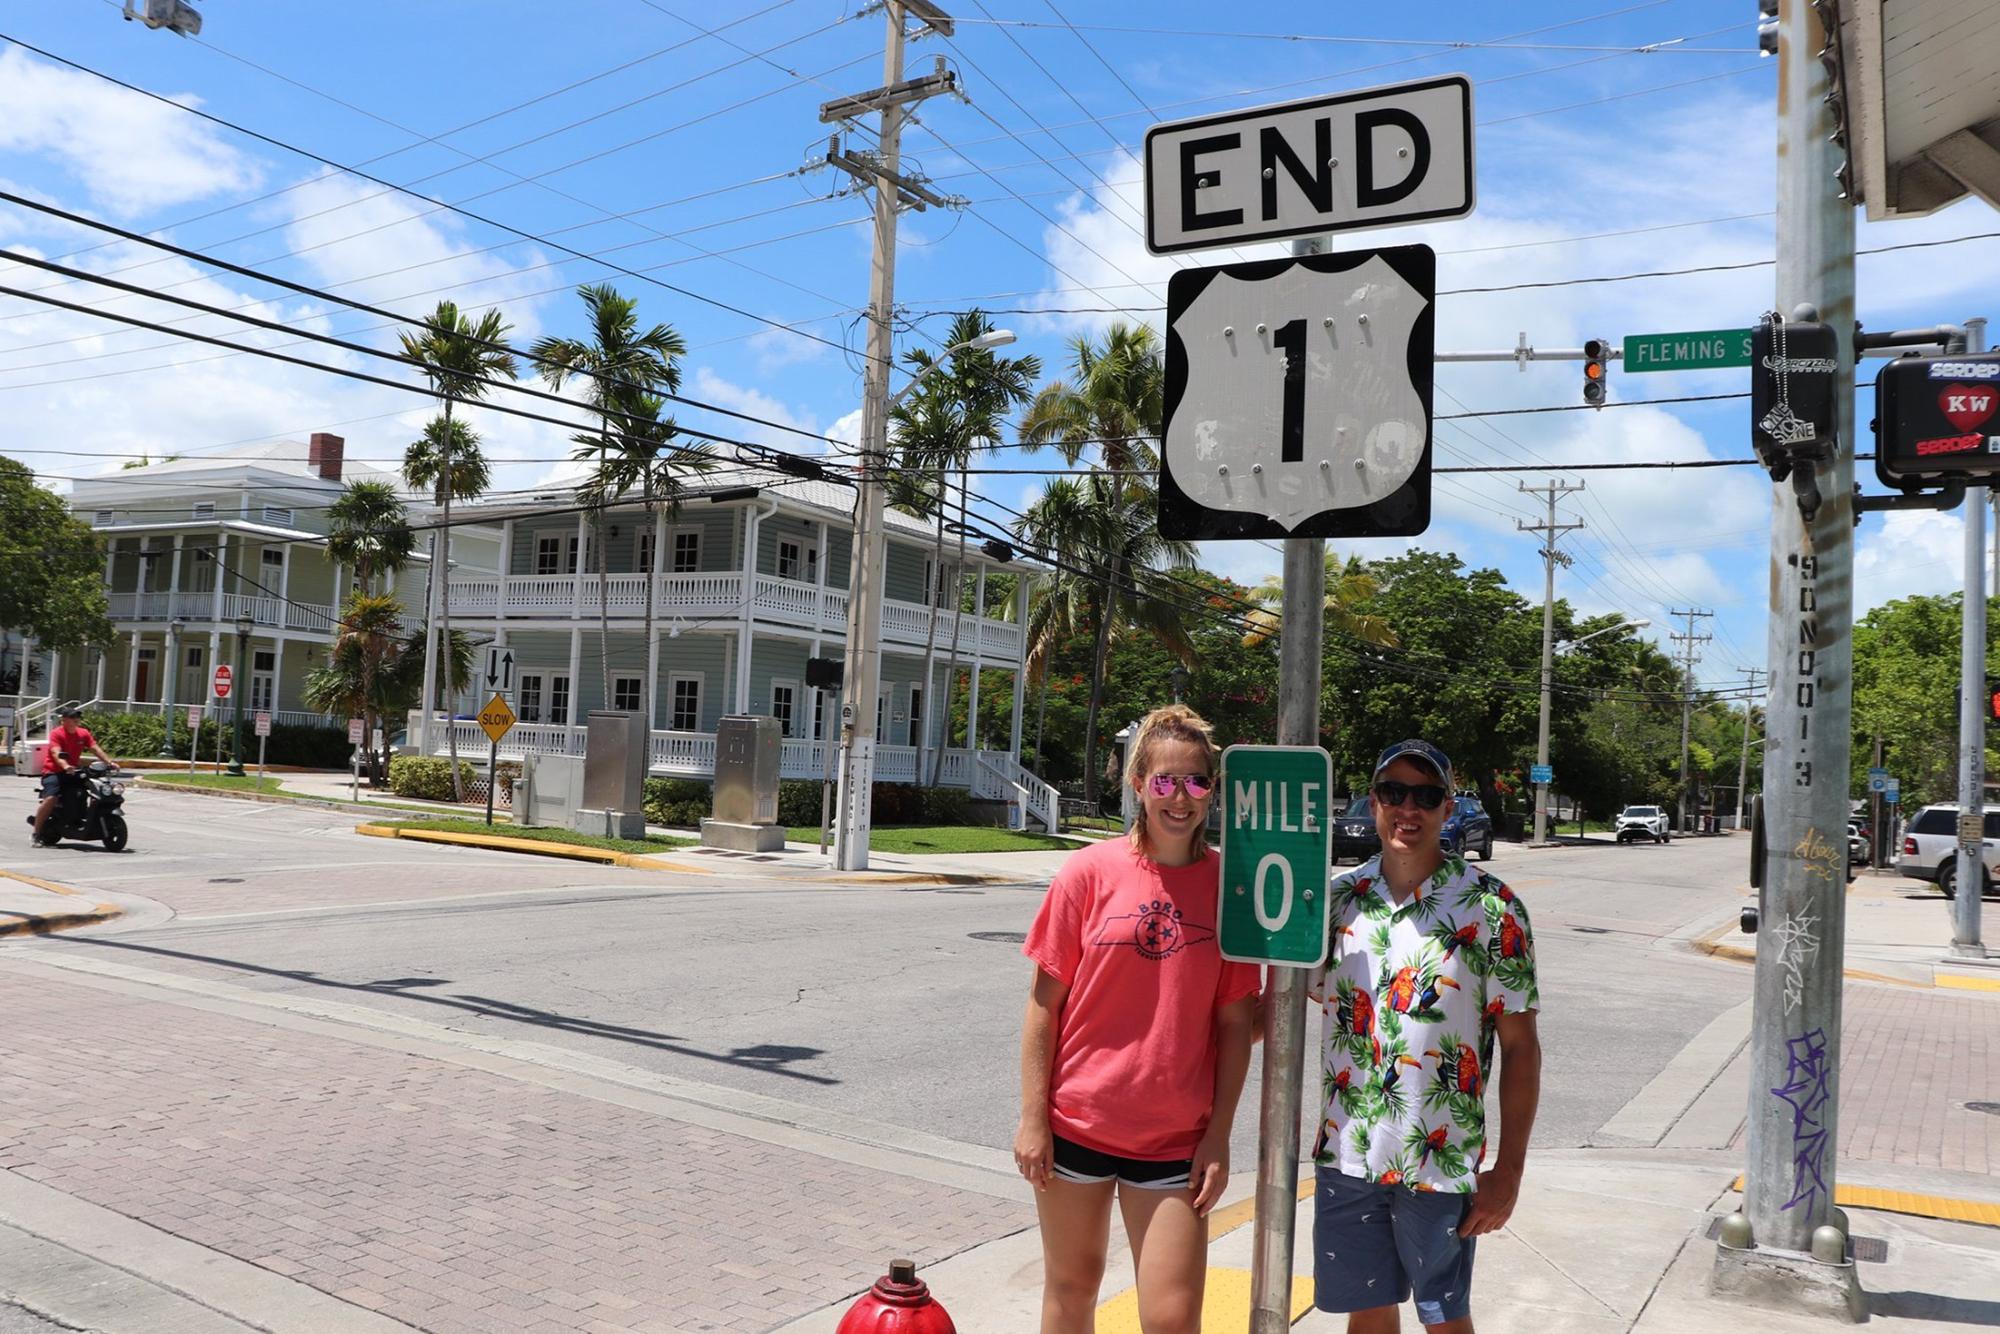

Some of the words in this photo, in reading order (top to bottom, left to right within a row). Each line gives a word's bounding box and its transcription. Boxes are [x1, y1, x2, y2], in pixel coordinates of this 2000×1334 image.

[1180, 107, 1431, 232] END
[1637, 339, 1726, 363] FLEMING
[1742, 339, 1752, 357] S
[1273, 318, 1307, 462] 1
[482, 713, 510, 725] SLOW
[1234, 780, 1321, 834] MILE
[1139, 900, 1183, 919] BORO
[1253, 852, 1294, 932] 0
